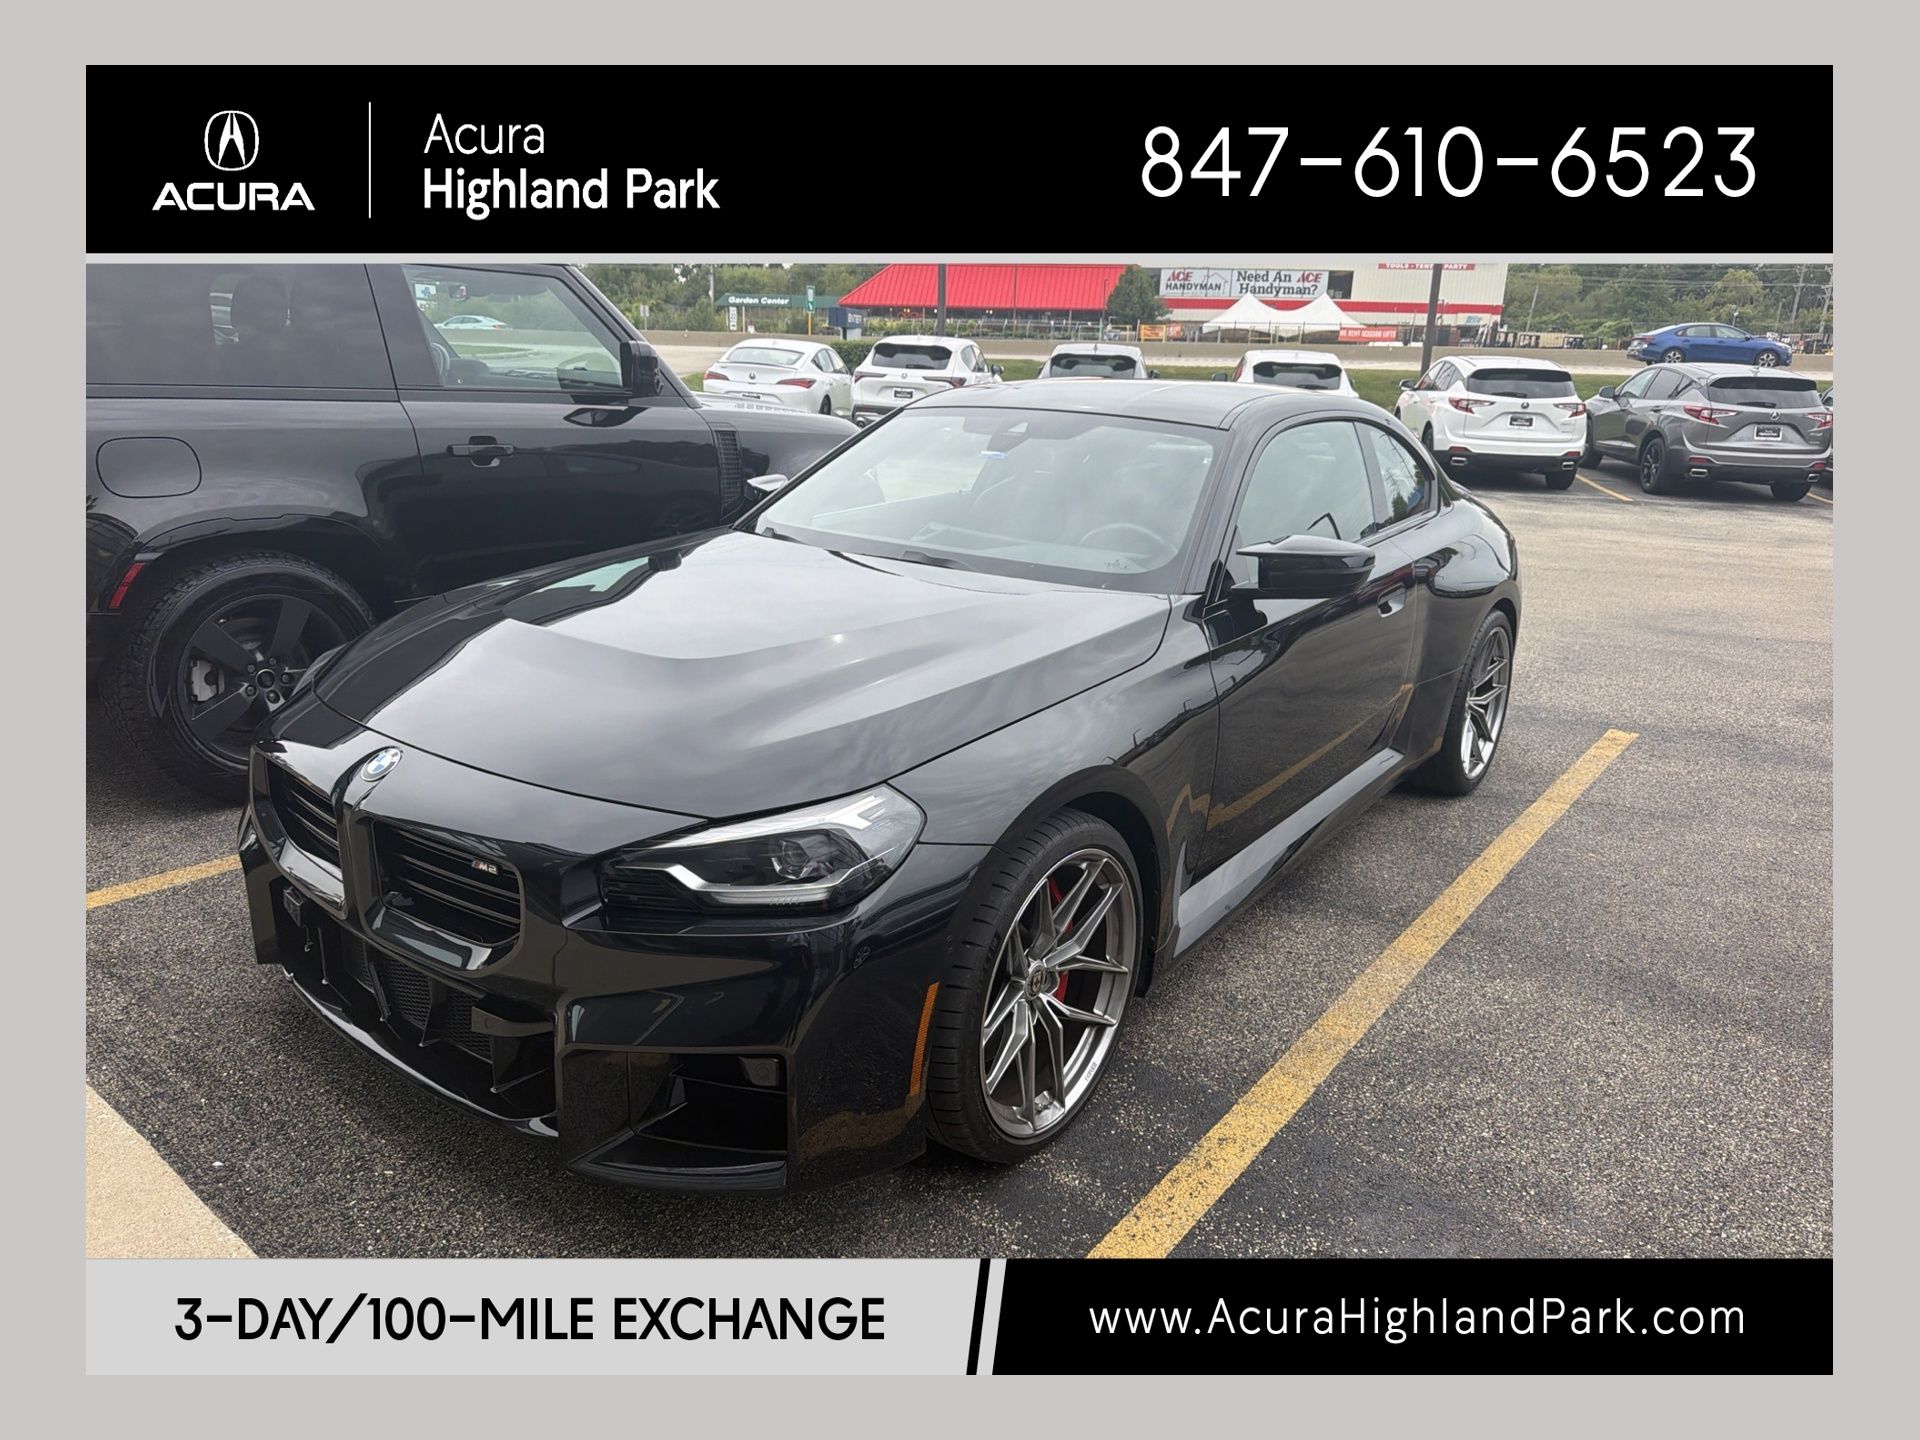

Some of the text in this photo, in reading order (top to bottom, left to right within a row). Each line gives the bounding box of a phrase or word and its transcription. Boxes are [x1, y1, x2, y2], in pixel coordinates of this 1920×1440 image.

[1167, 271, 1193, 282] ACE
[1236, 270, 1323, 283] Need An ACE
[1165, 282, 1222, 291] HANDYMAN
[1239, 283, 1318, 297] Handyman?
[728, 296, 790, 305] Garden Center
